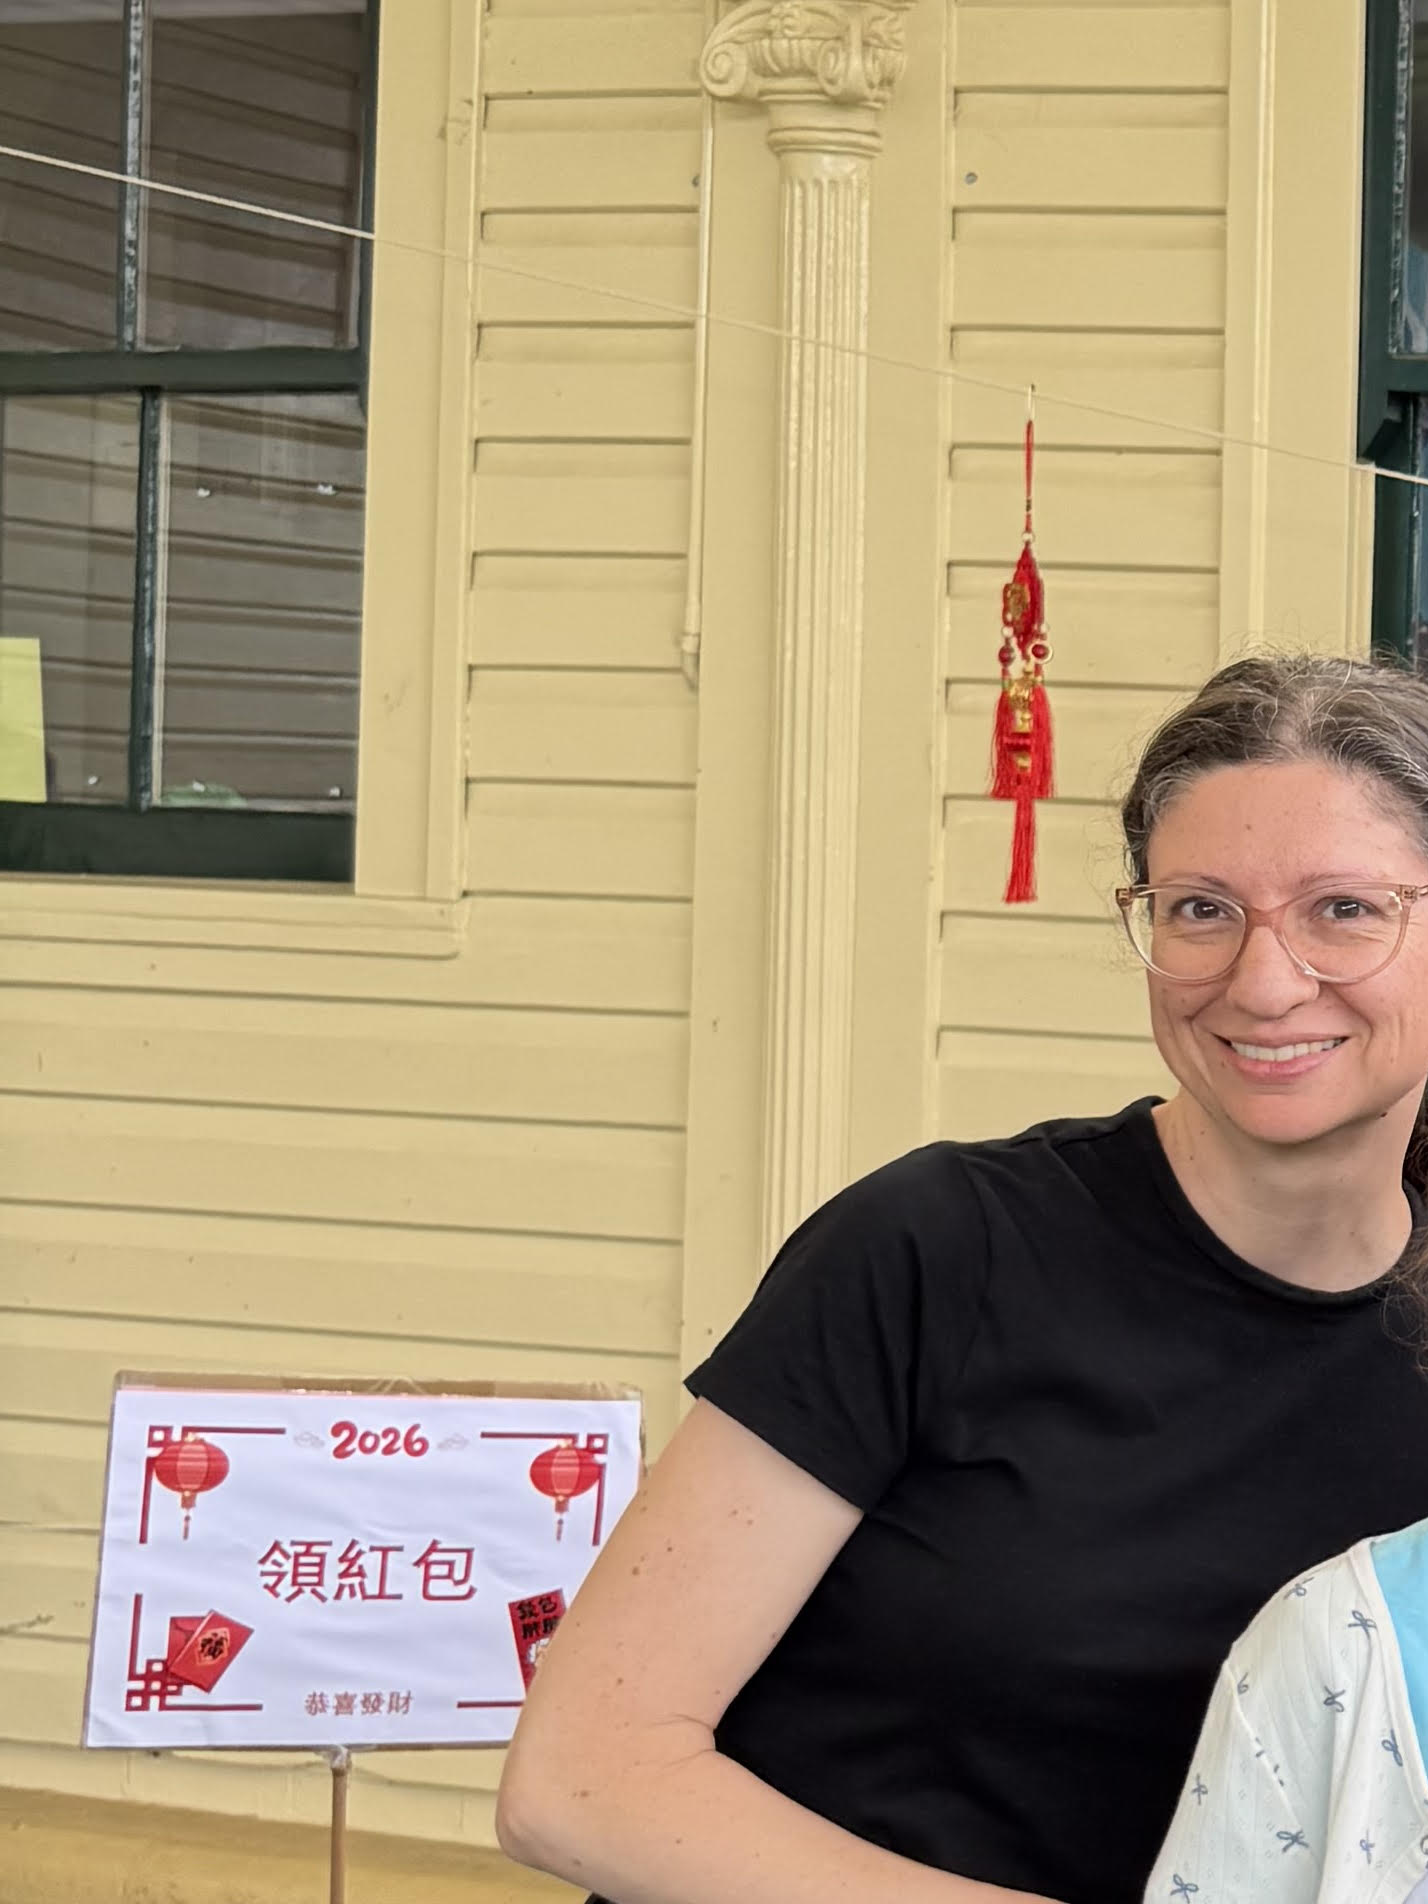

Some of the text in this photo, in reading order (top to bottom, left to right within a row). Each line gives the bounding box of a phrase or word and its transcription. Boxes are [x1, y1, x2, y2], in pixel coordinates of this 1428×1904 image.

[329, 1420, 430, 1460] 2026
[257, 1538, 478, 1604] 領紅包
[304, 1690, 413, 1717] 恭喜發財
